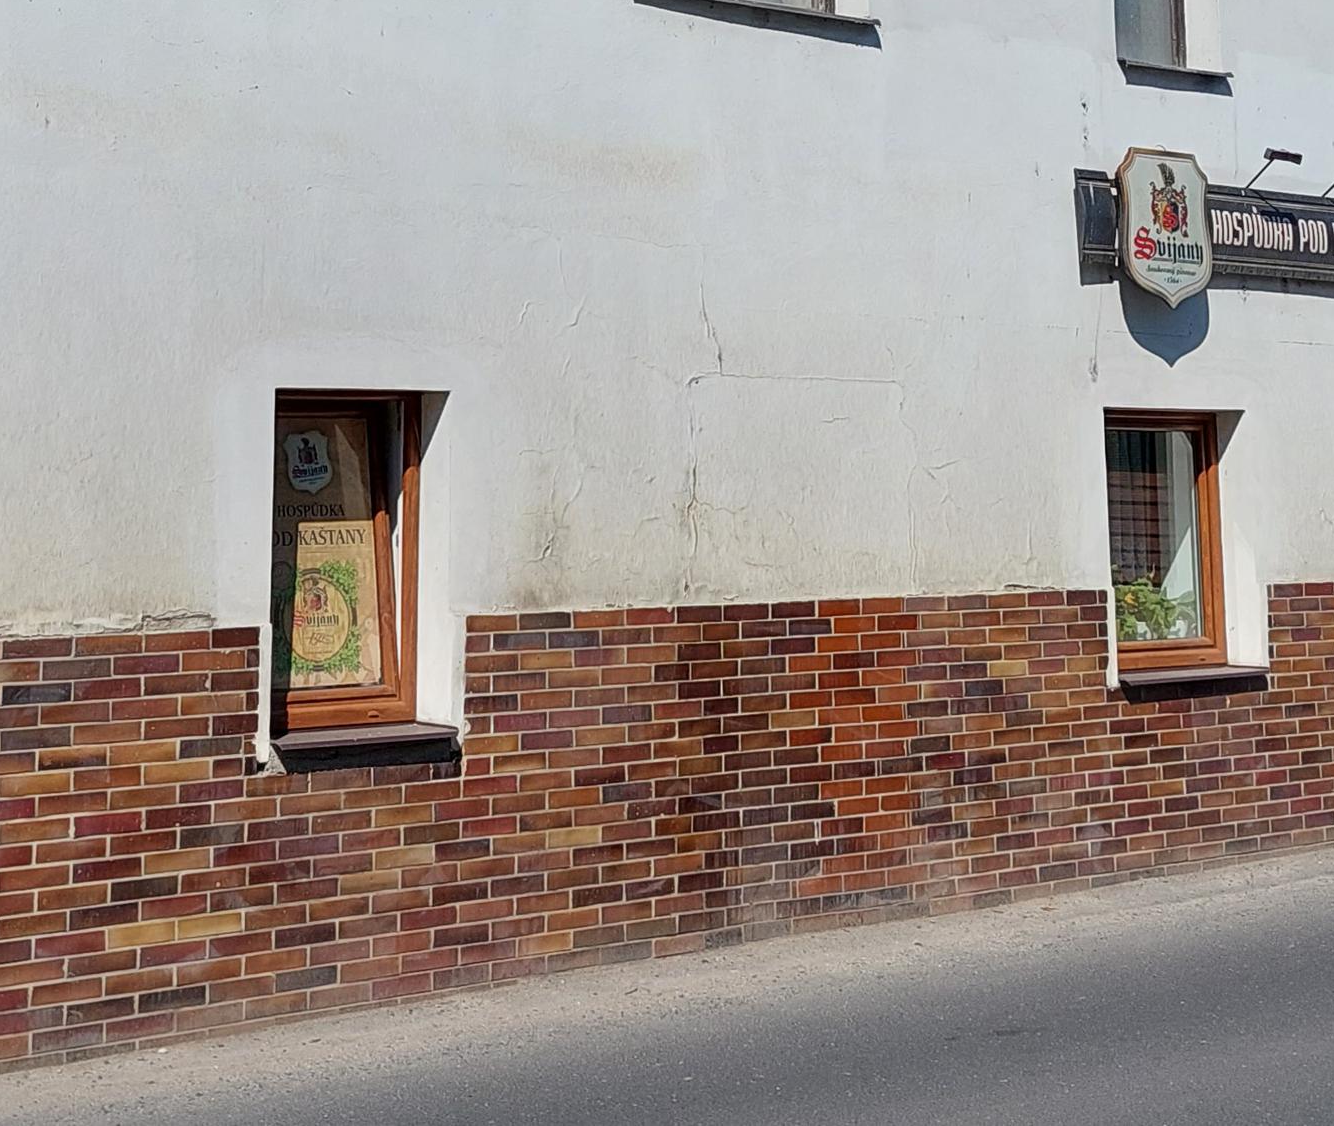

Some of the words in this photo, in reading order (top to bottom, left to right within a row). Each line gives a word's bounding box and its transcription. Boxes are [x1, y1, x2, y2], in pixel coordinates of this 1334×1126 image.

[1211, 206, 1294, 252] HOSPŮDKA
[1297, 218, 1328, 254] POD
[1133, 226, 1204, 267] Svijany
[277, 502, 346, 519] HOSPŮDKA
[273, 530, 293, 547] OD
[298, 526, 366, 546] KAŠTANY
